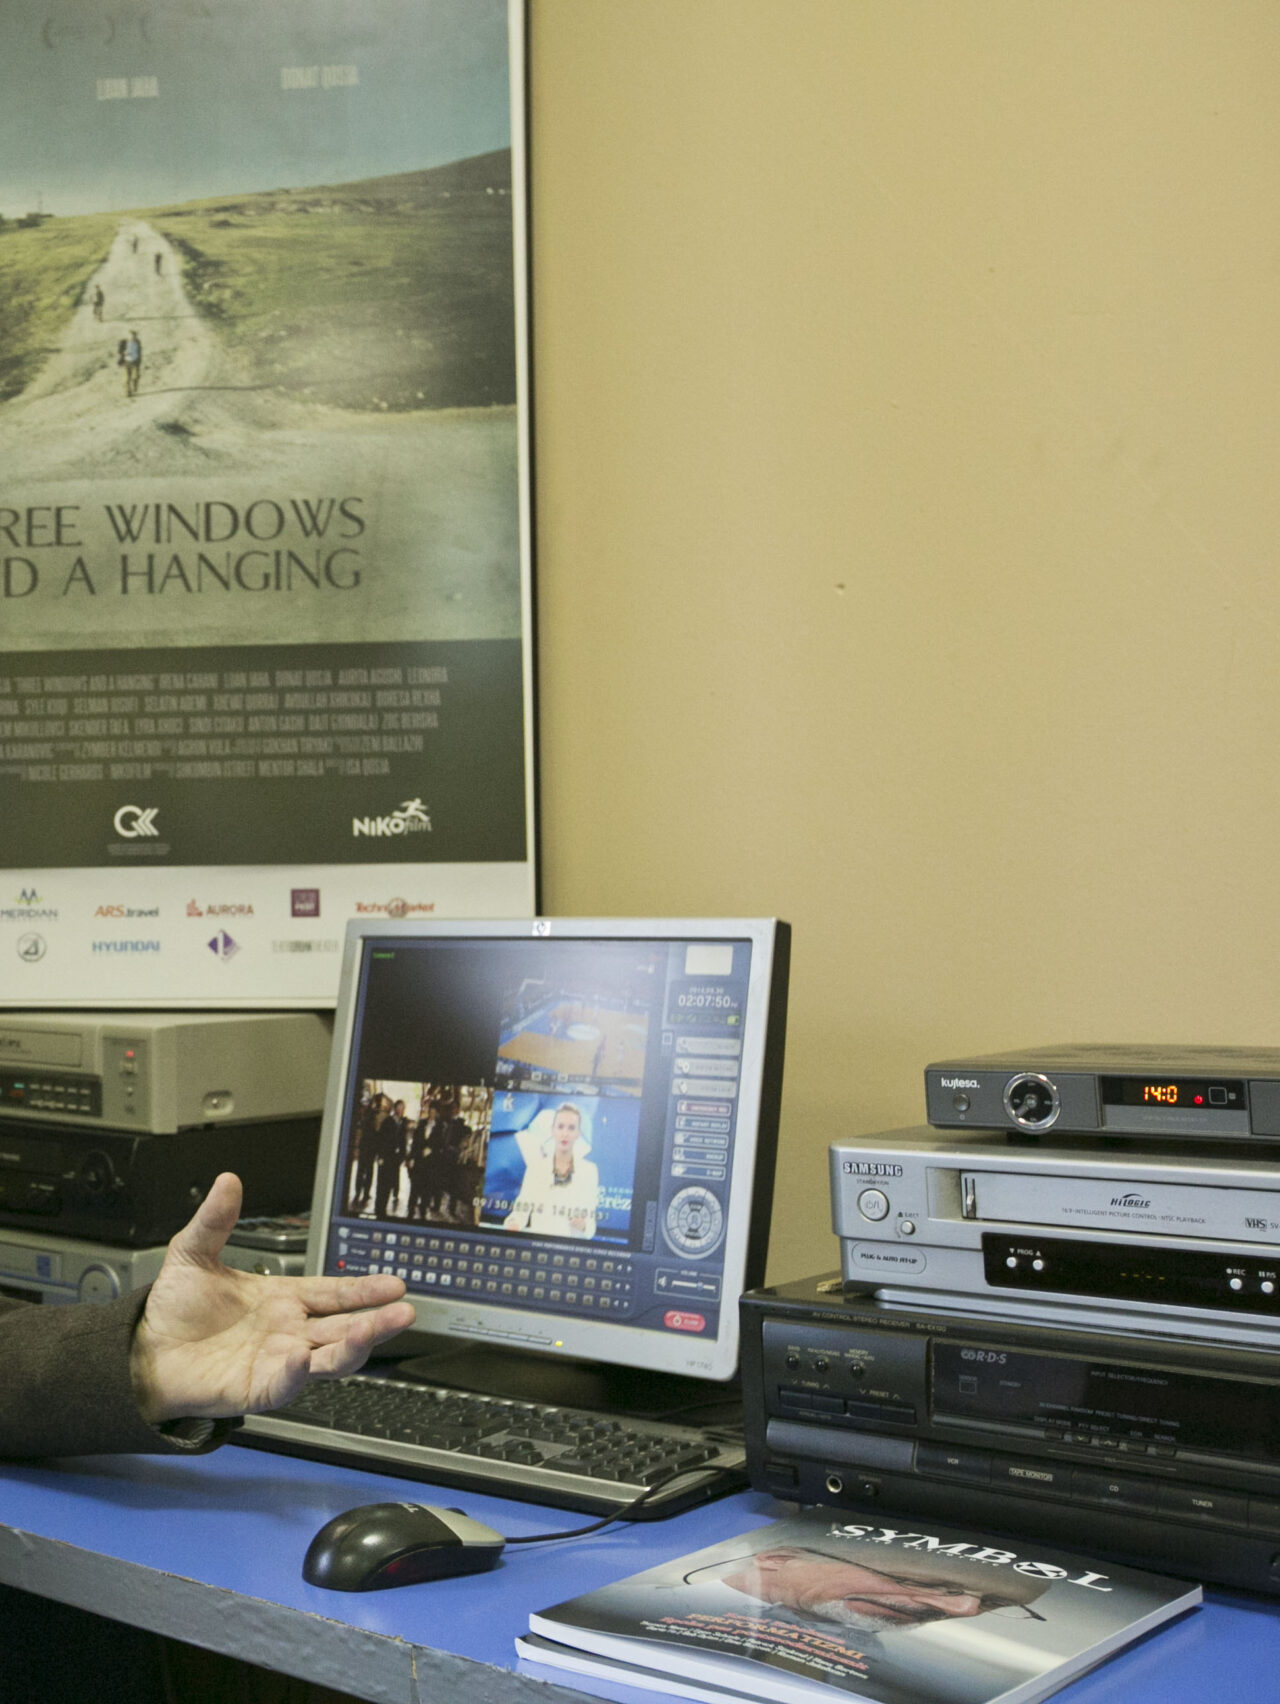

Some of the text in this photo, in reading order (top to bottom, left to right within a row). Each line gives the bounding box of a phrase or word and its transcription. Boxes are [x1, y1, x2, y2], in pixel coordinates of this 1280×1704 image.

[104, 496, 367, 544] WINDOWS
[63, 555, 96, 596] A
[120, 547, 363, 595] HANGING
[0, 908, 58, 920] MERIDIAN
[206, 903, 254, 917] AURORA
[678, 994, 731, 1008] 02:07:50
[843, 1162, 903, 1177] SAMSUNG
[1245, 1217, 1267, 1230] VHS
[1233, 1268, 1246, 1276] REC
[1192, 1499, 1213, 1508] TUNER
[685, 1613, 865, 1660] PERFORMATIZMI
